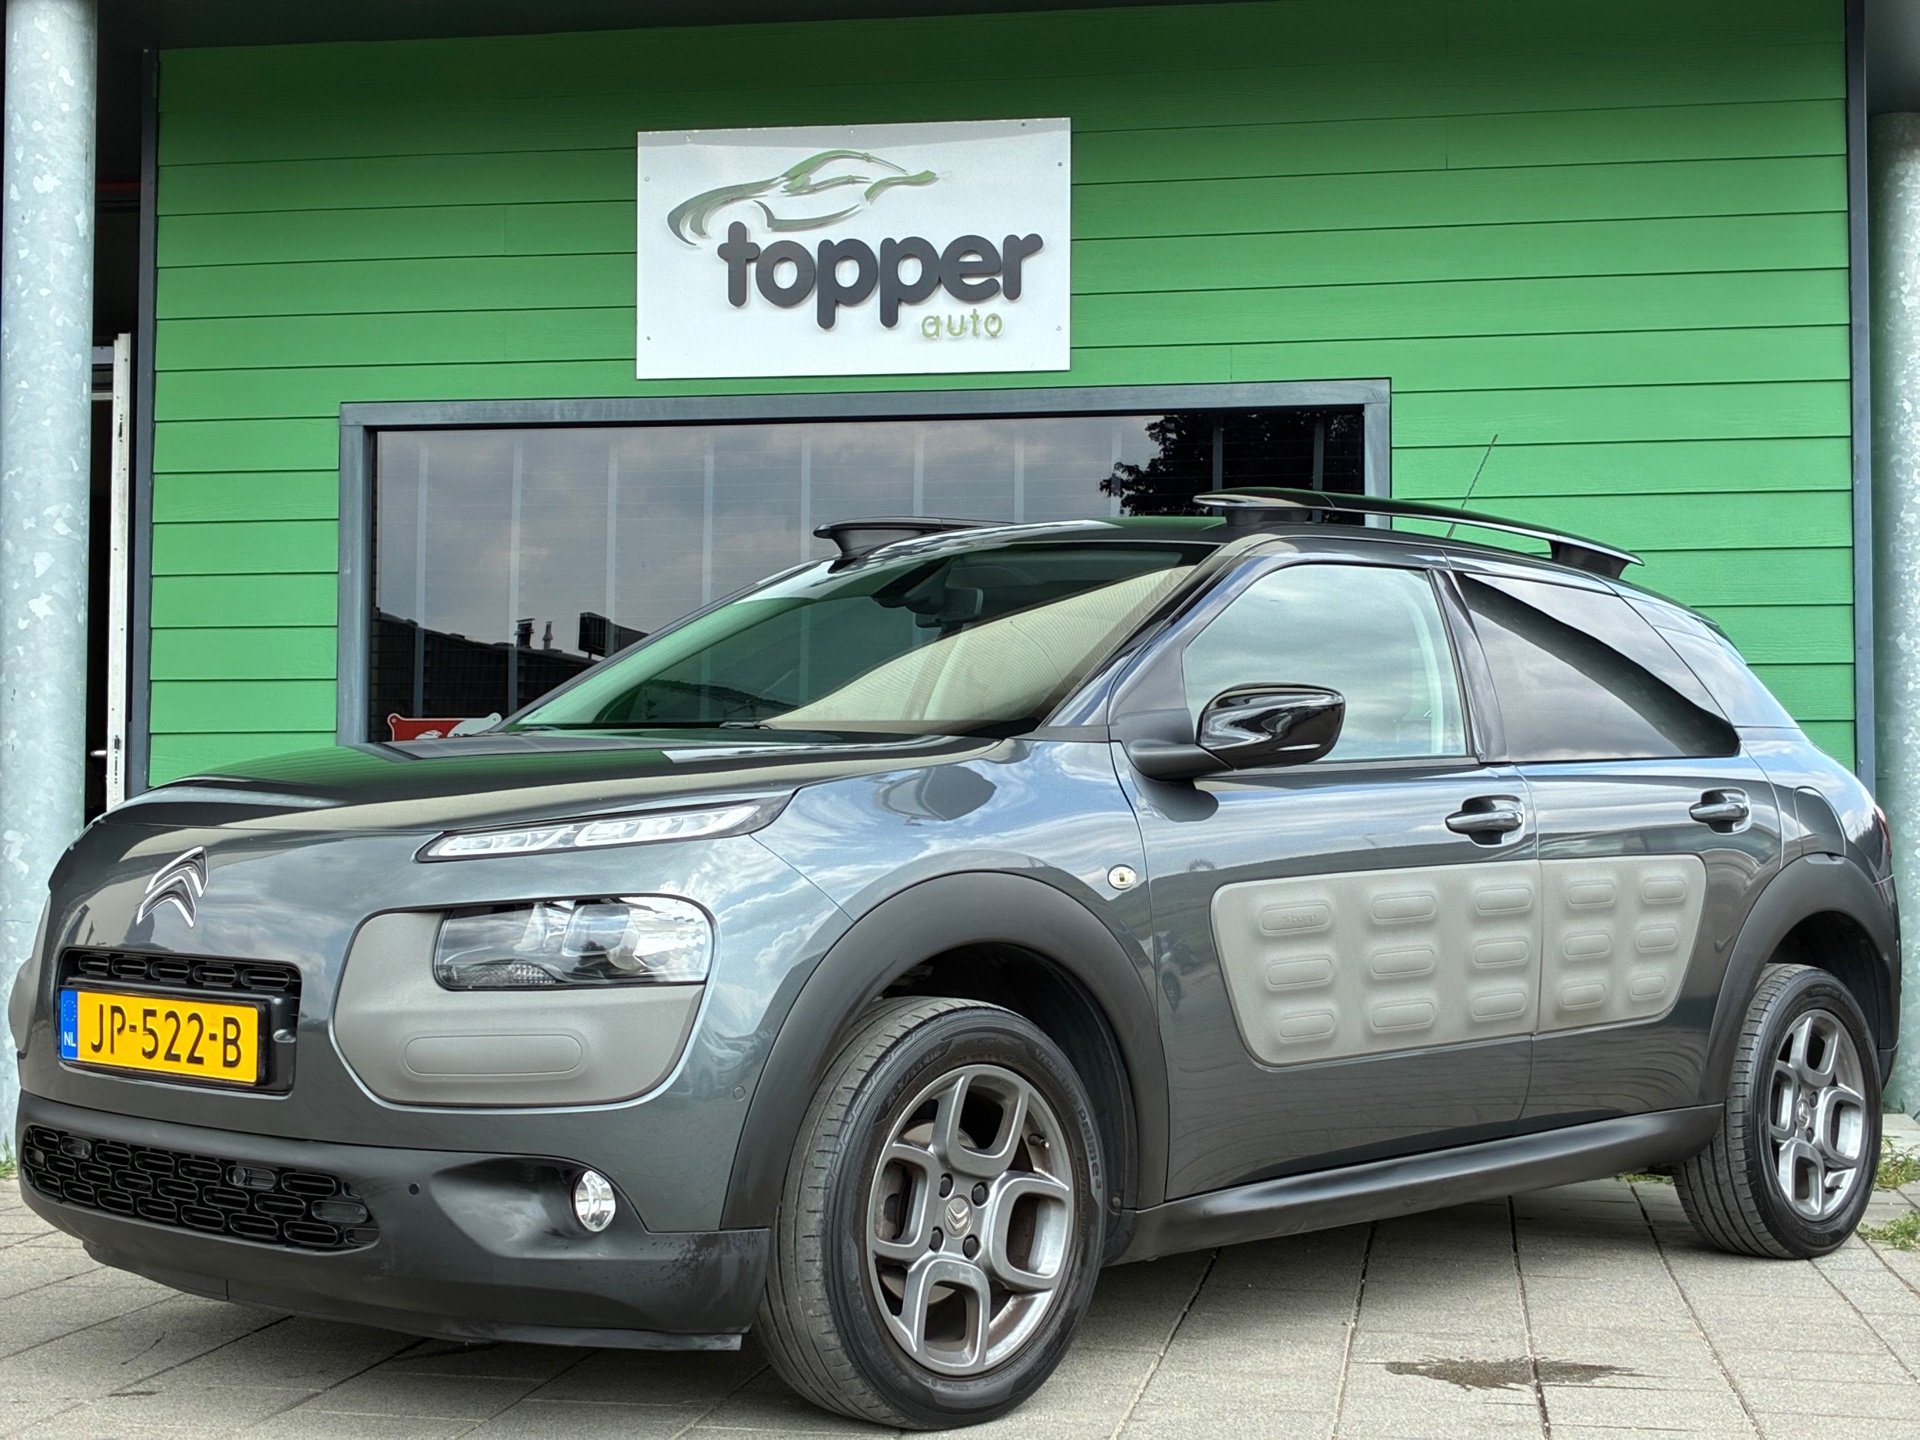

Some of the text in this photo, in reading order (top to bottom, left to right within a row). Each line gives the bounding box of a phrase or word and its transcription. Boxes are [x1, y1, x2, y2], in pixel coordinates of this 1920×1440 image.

[717, 221, 1044, 330] topper
[921, 308, 1003, 338] auto
[64, 1031, 76, 1048] NL
[91, 1004, 241, 1068] JP-522-B
